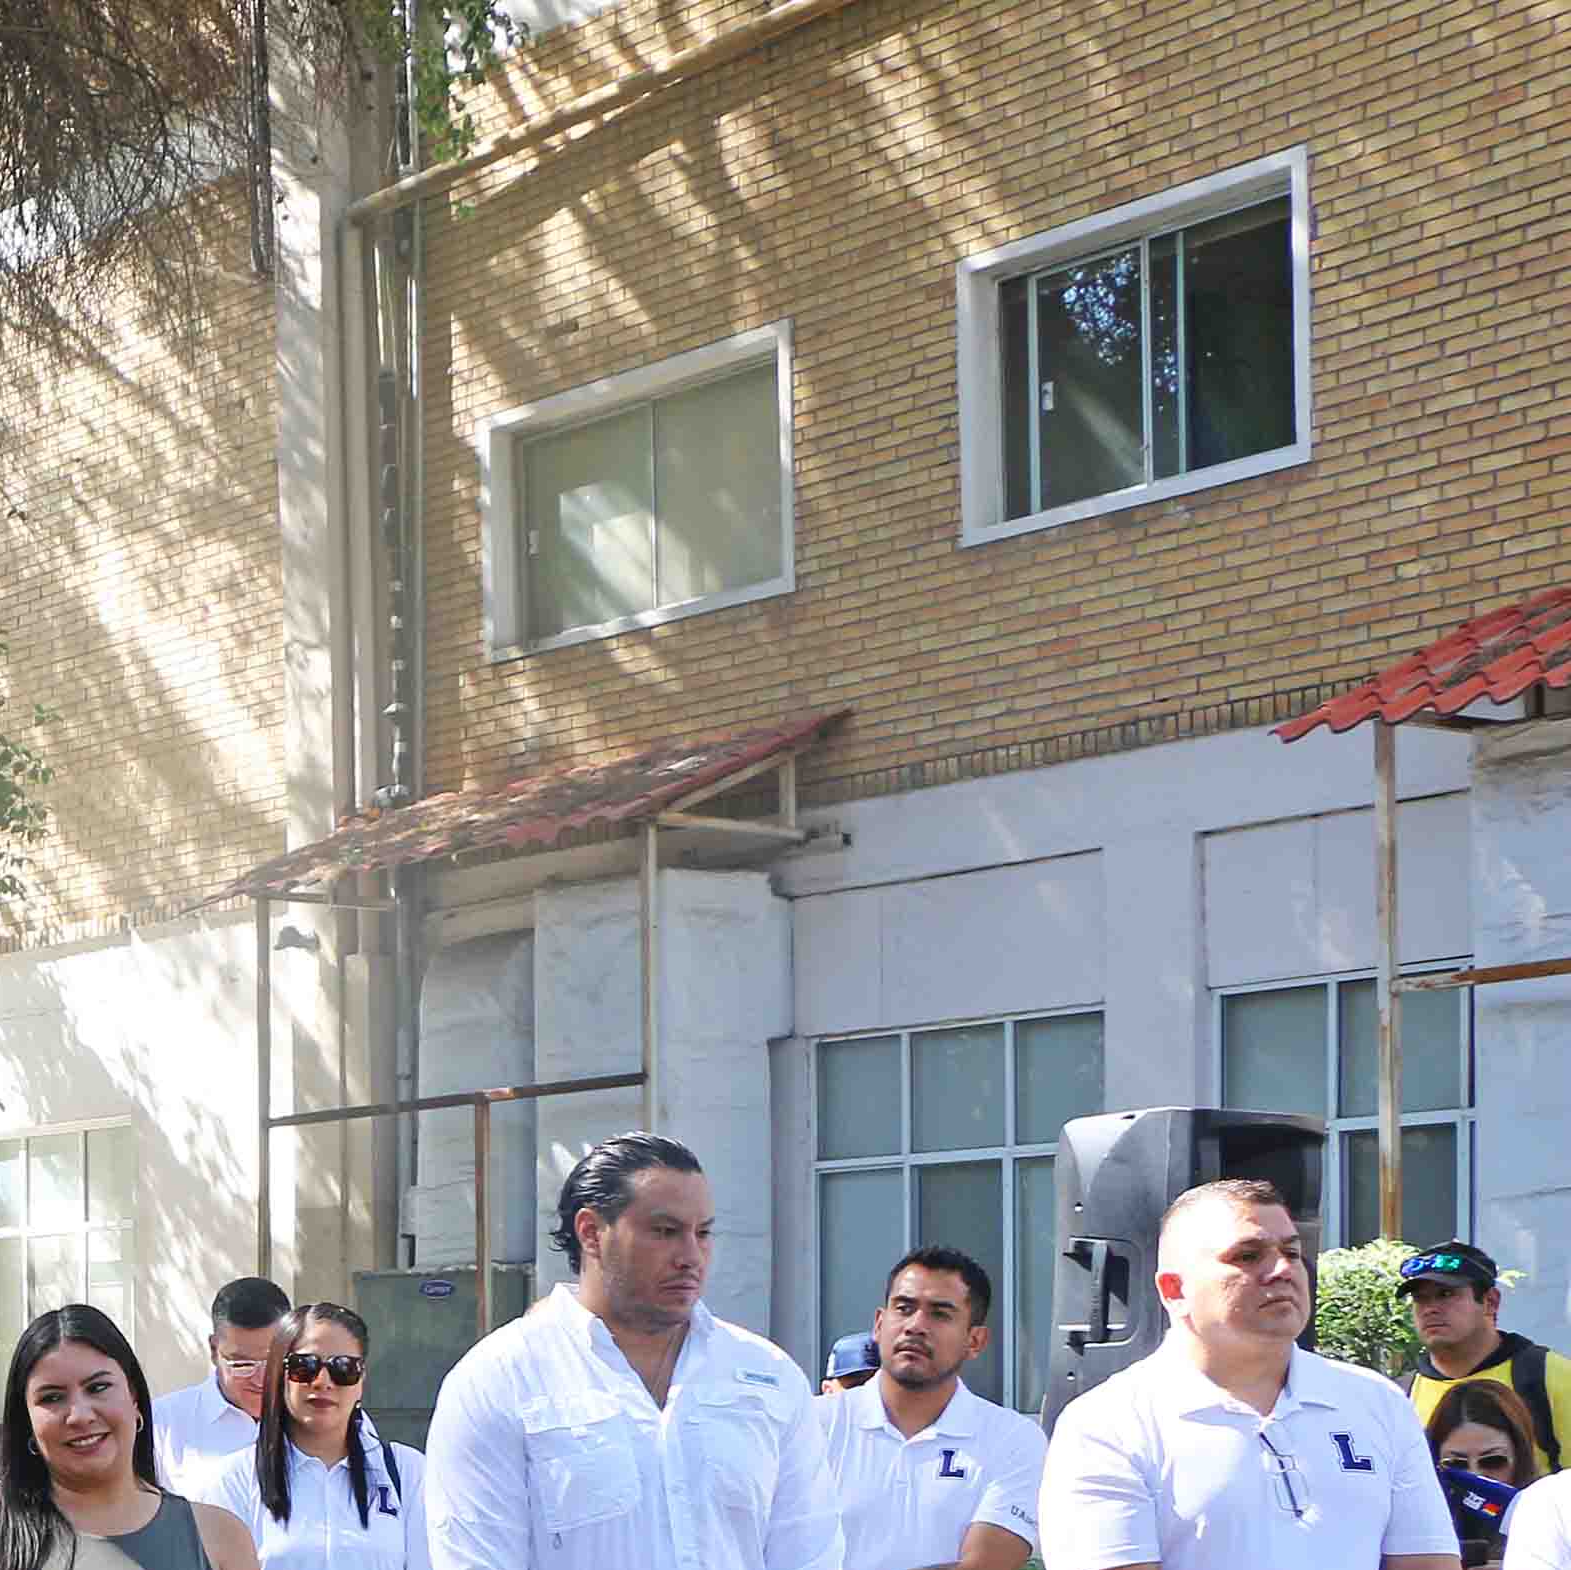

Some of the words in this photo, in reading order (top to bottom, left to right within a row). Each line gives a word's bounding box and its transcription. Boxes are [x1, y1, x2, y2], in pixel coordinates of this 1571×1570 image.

[939, 1449, 964, 1478] L
[1331, 1432, 1374, 1472] L
[377, 1485, 398, 1517] L
